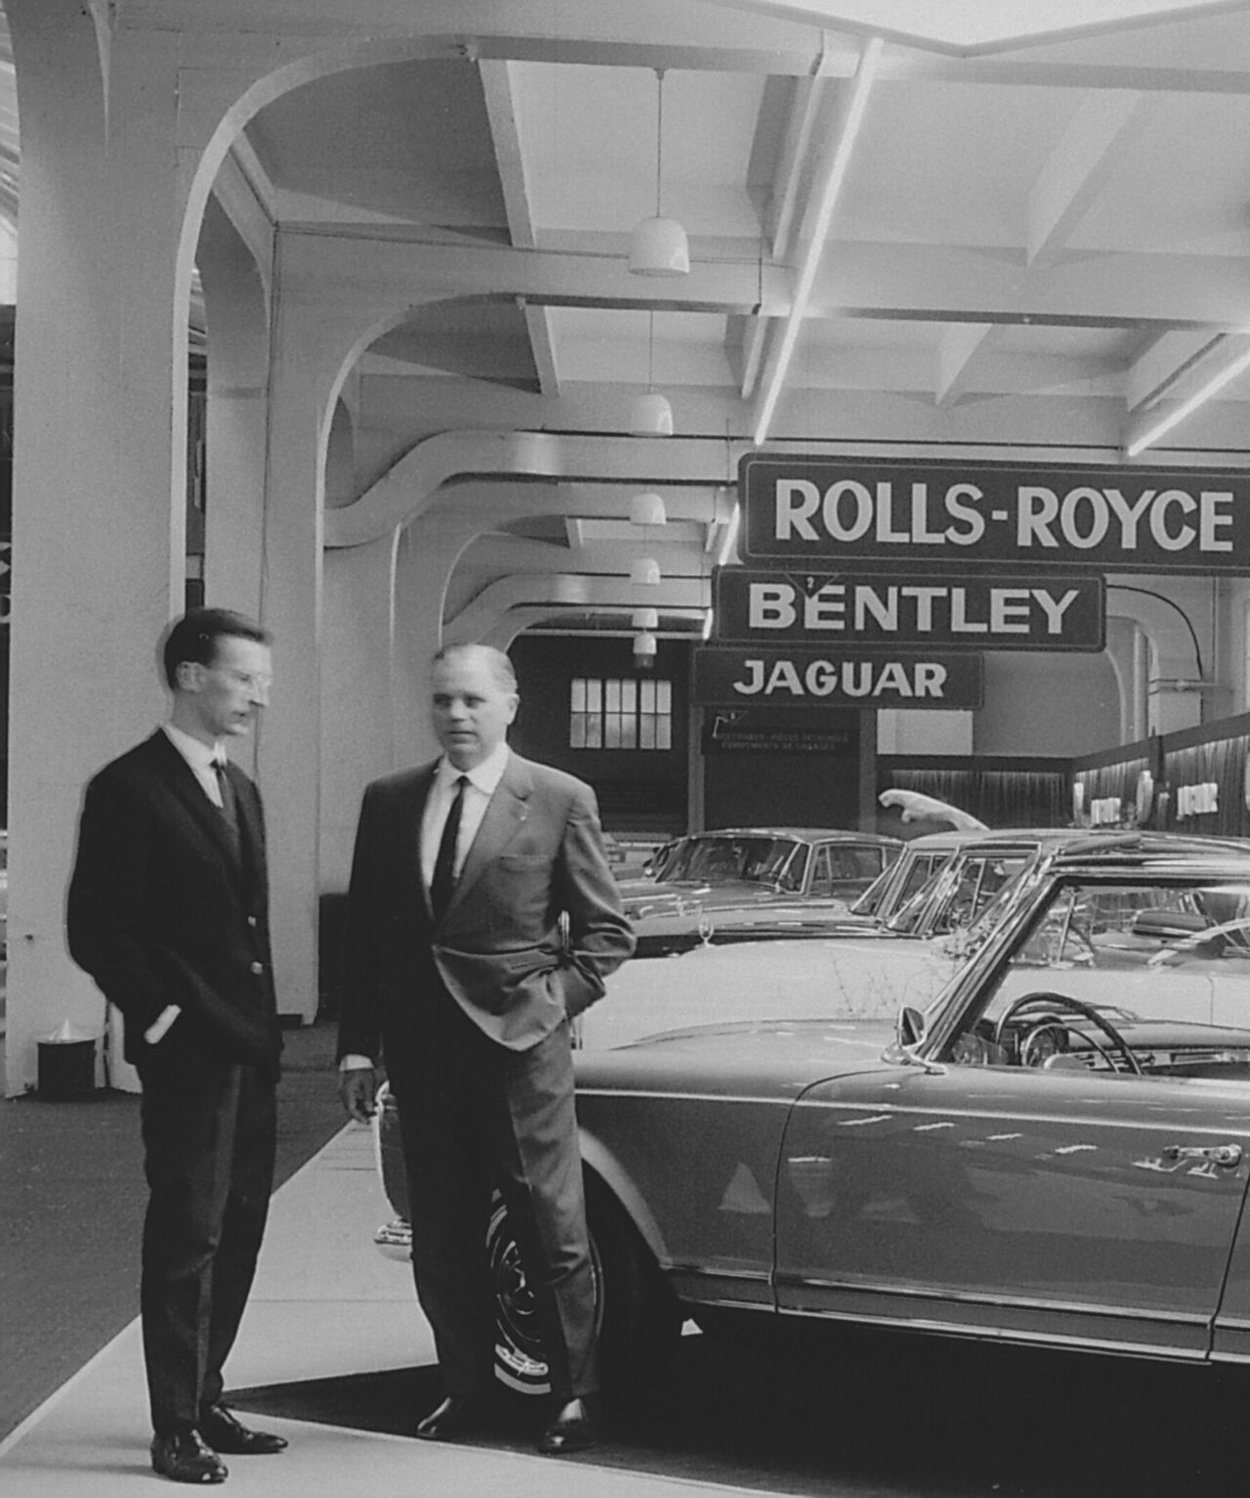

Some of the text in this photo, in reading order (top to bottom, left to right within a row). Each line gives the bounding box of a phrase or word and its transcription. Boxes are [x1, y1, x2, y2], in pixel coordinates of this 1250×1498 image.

[774, 478, 1235, 552] ROLLS-ROYCE
[748, 582, 1080, 635] BENTLEY
[732, 658, 948, 698] JAGUAR
